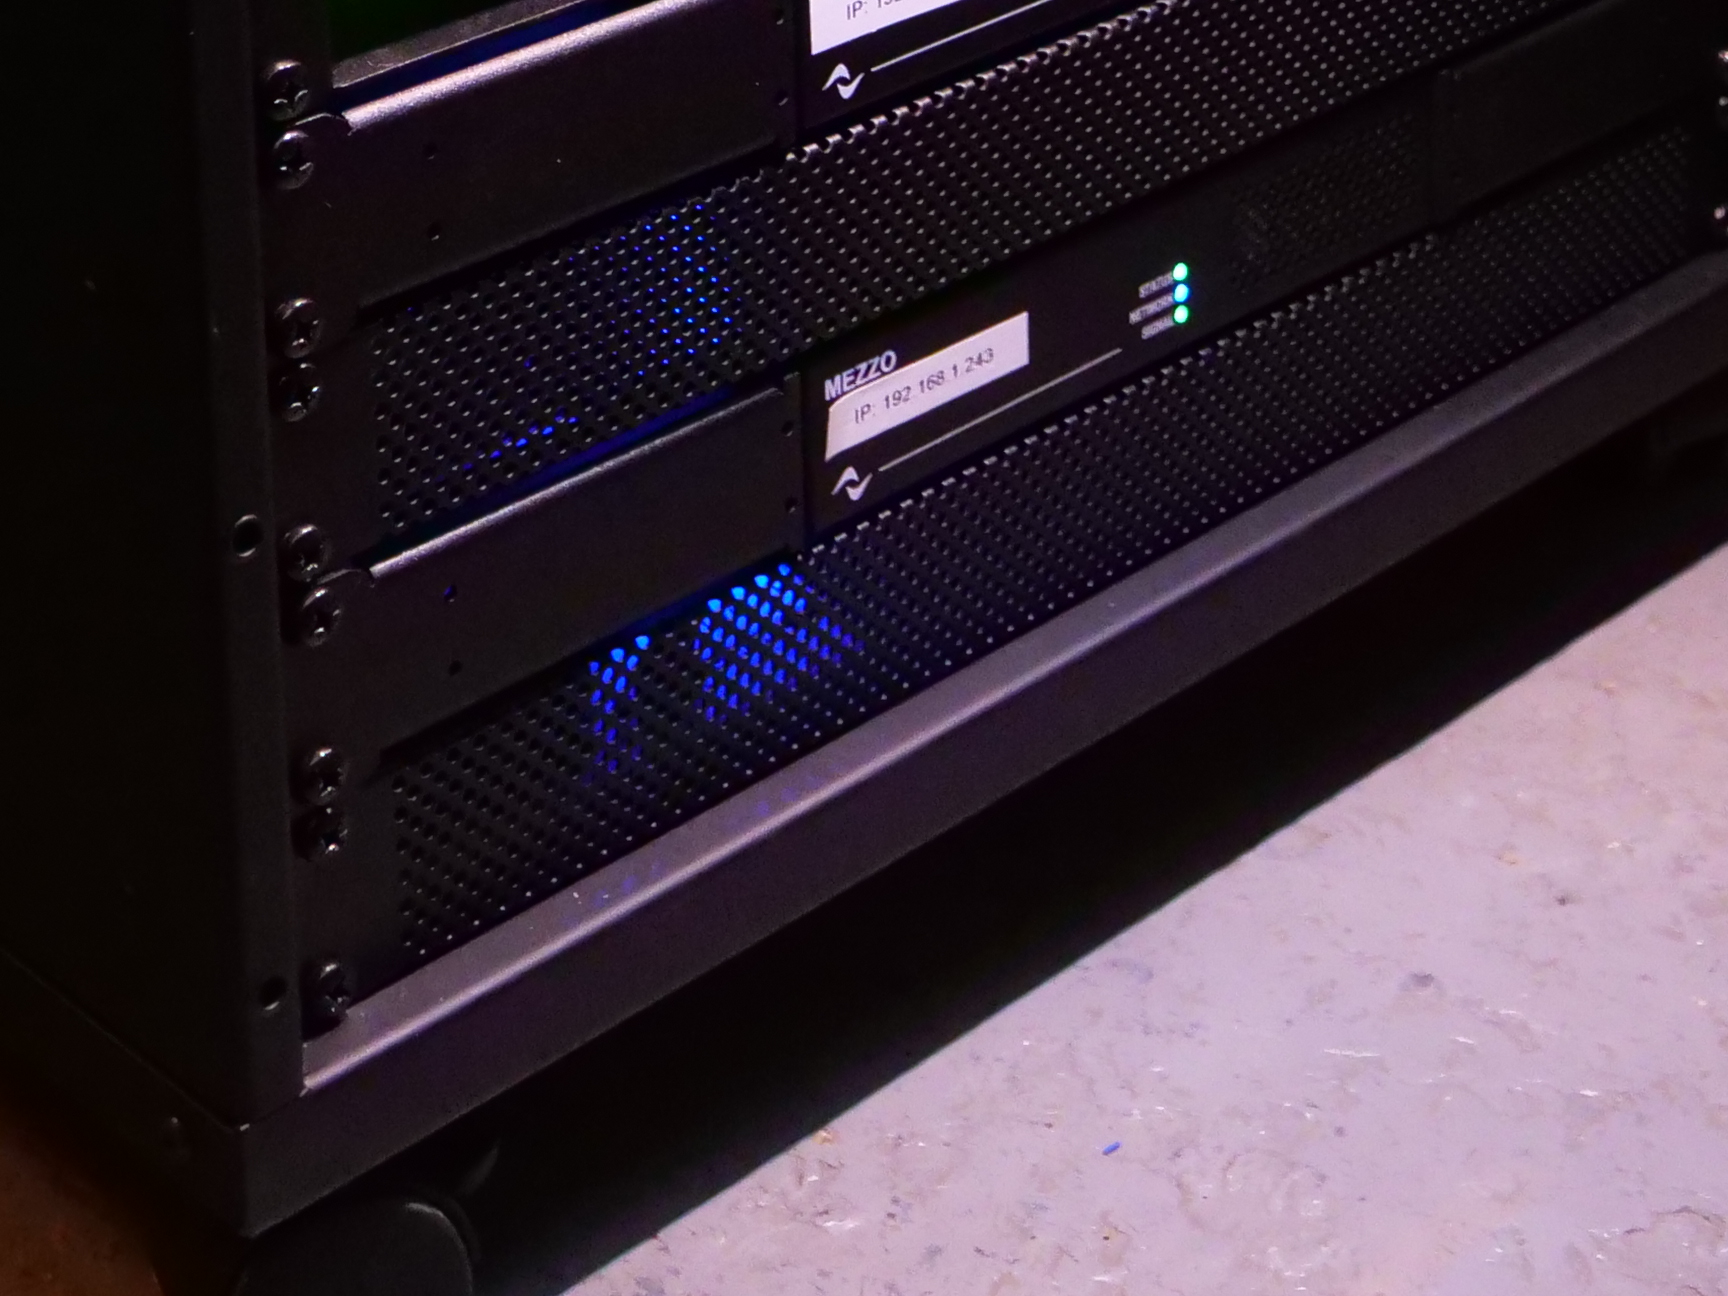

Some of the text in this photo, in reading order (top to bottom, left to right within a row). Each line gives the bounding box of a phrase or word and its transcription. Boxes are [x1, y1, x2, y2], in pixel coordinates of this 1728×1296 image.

[846, 0, 869, 21] IP:
[824, 350, 897, 401] MEZZO
[854, 403, 876, 424] IP:
